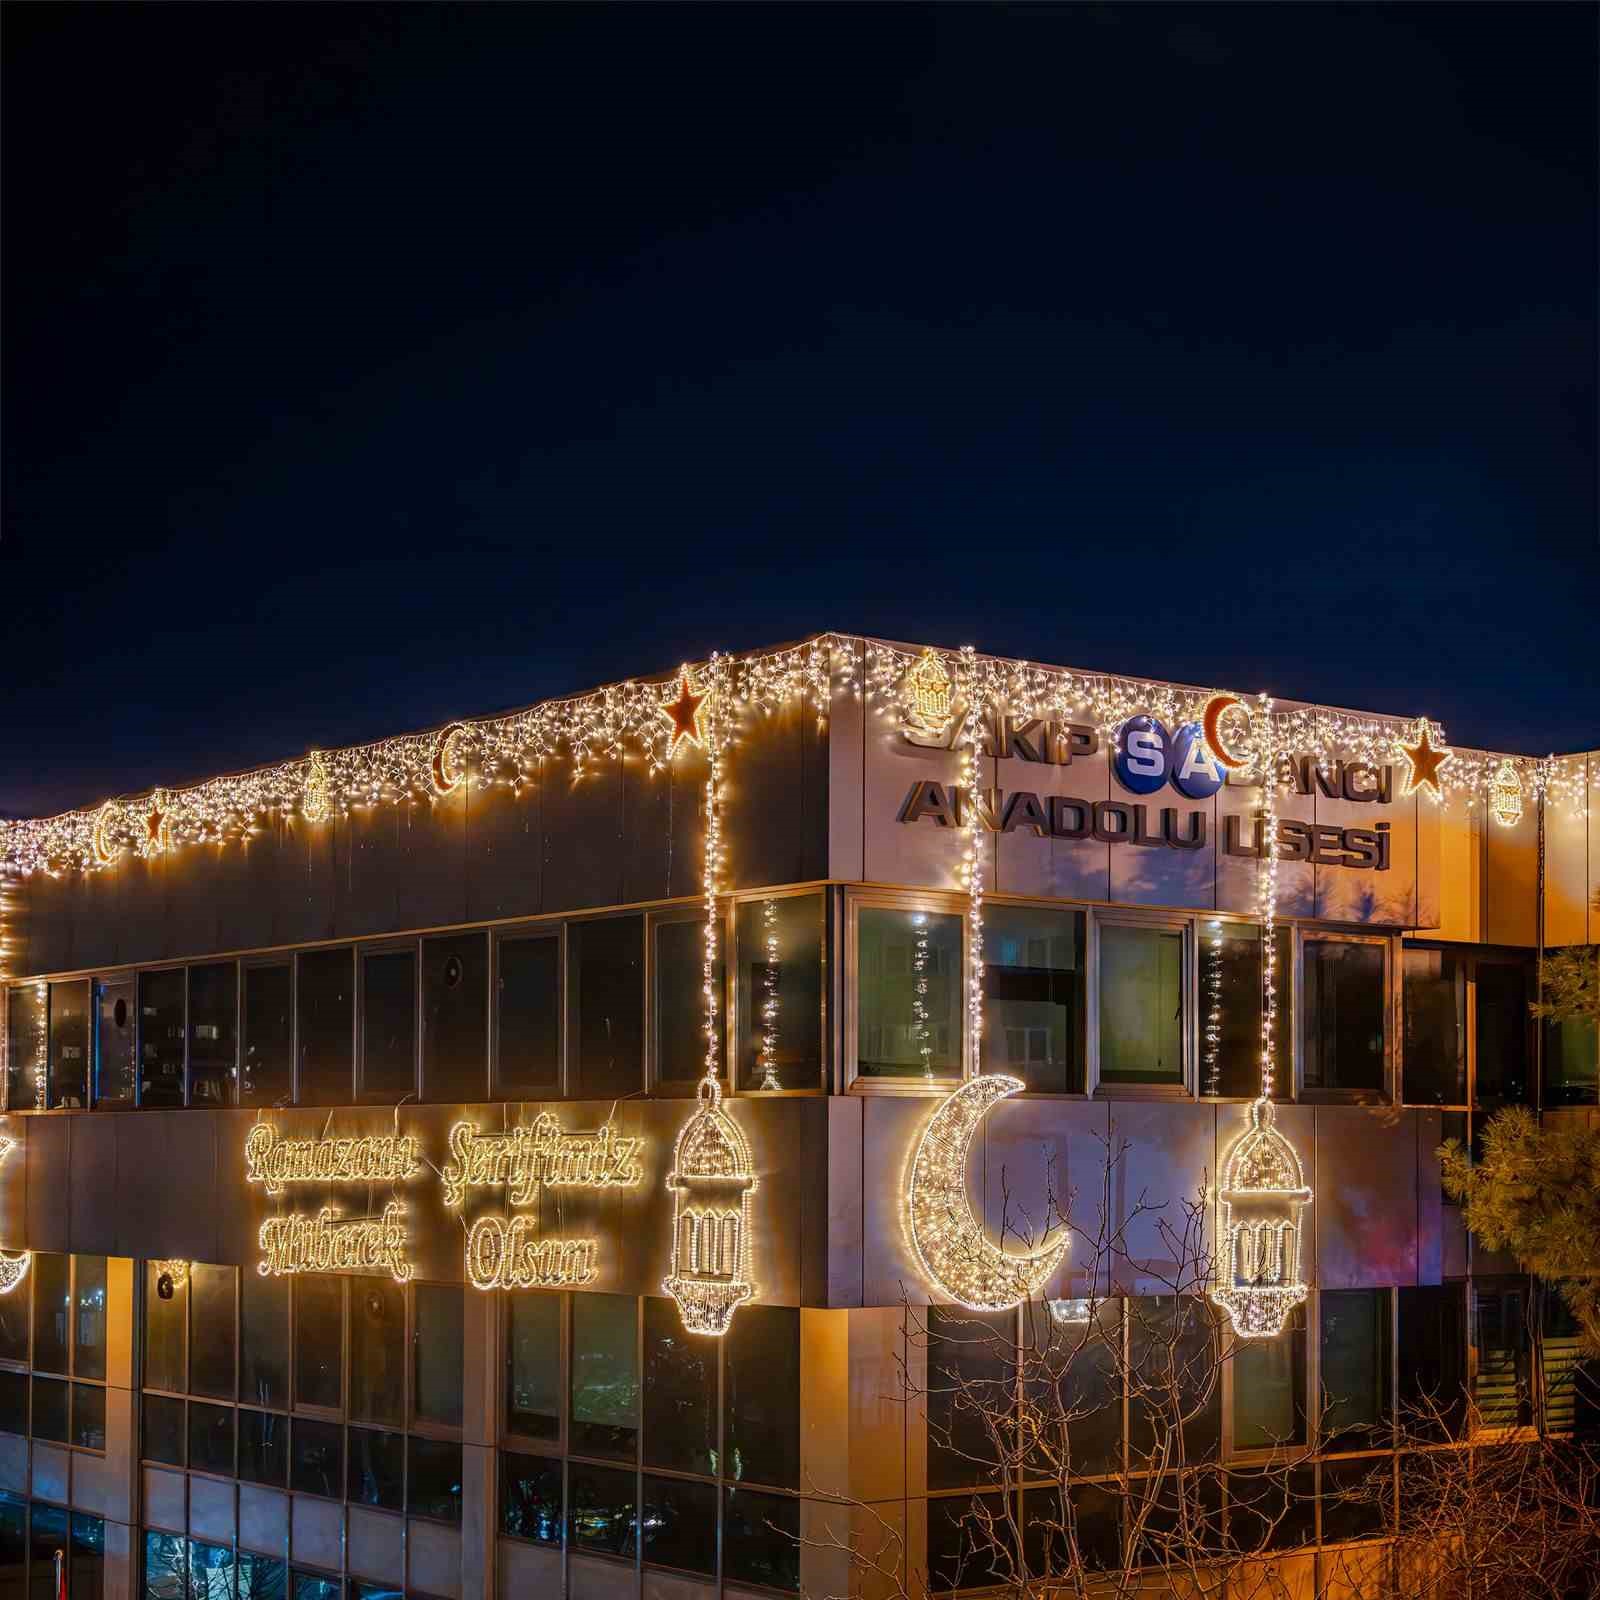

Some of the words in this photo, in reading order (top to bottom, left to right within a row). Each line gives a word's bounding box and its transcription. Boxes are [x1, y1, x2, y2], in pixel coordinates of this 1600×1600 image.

[896, 780, 1207, 850] ANADOLU
[1222, 808, 1392, 872] LİSESİ
[441, 1112, 646, 1206] Şerifimiz
[257, 1202, 415, 1283] Mübarek
[466, 1216, 599, 1290] Olsun
